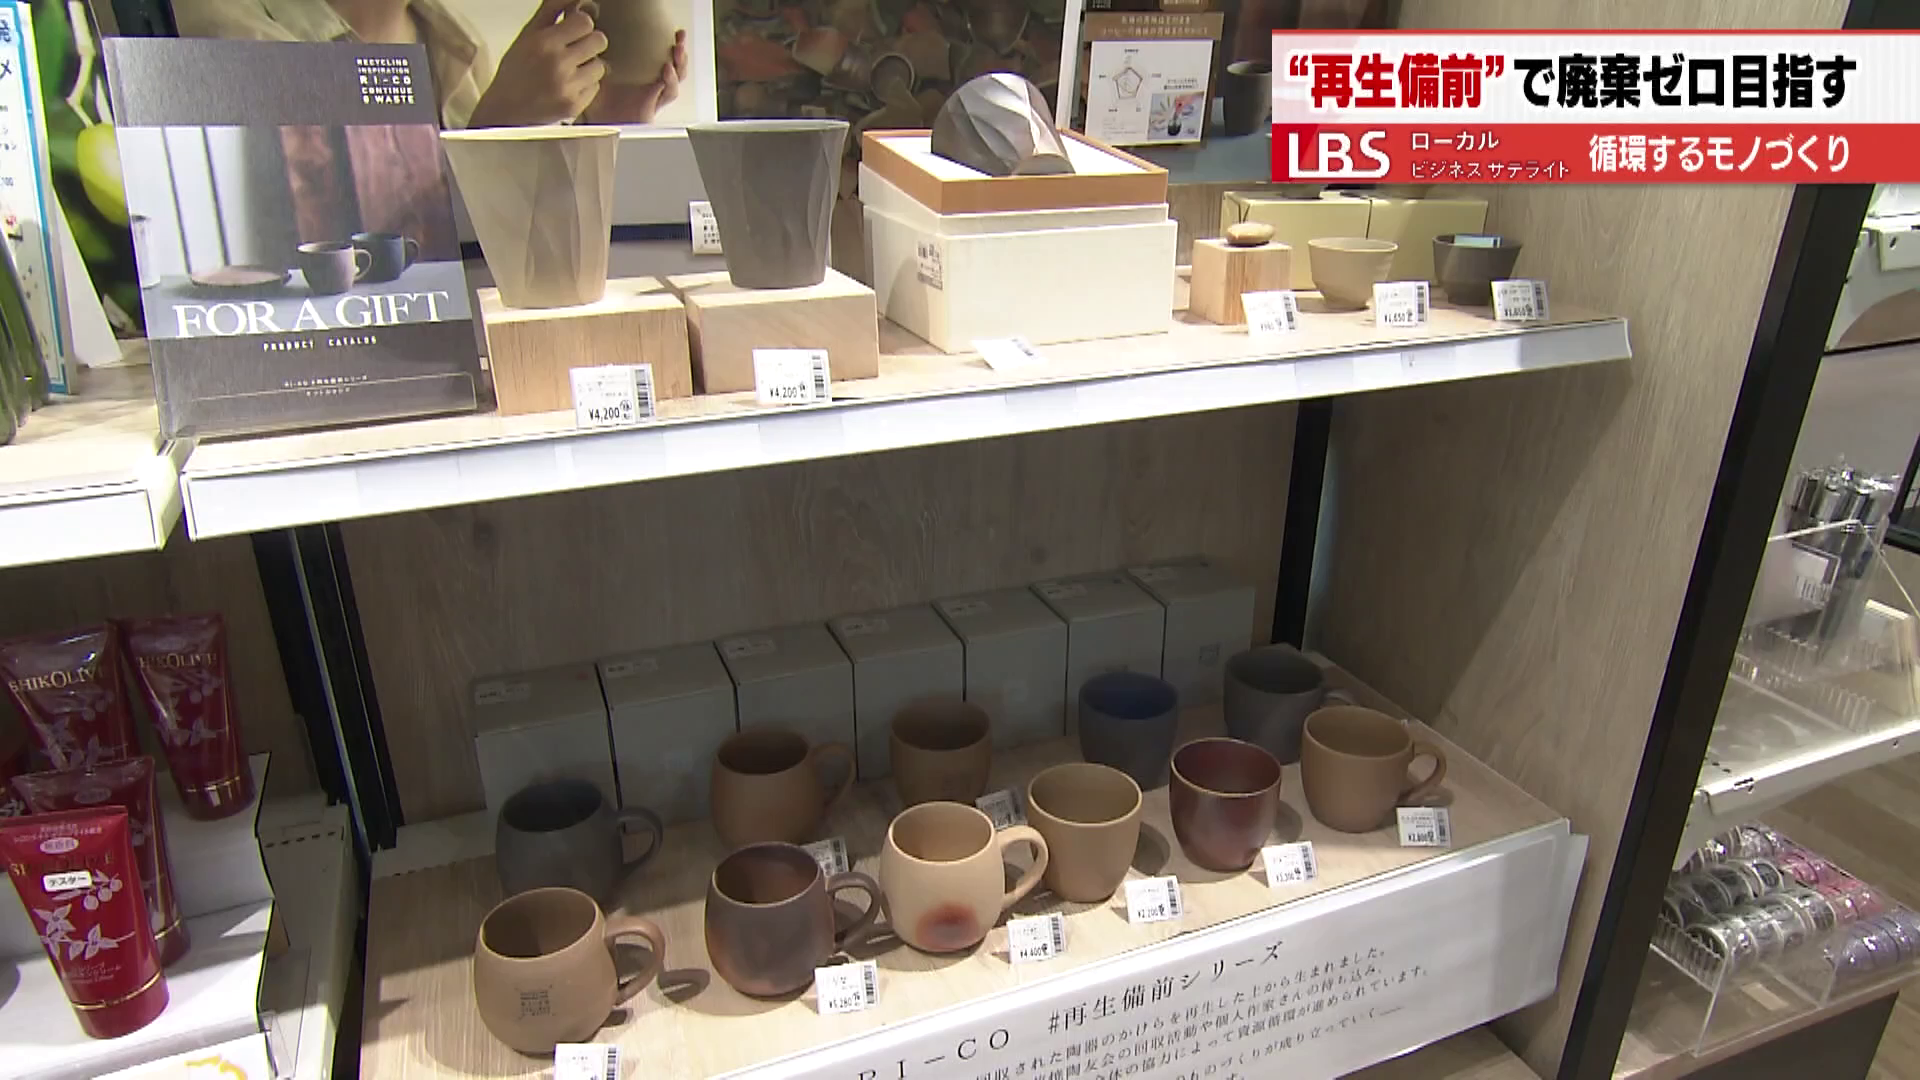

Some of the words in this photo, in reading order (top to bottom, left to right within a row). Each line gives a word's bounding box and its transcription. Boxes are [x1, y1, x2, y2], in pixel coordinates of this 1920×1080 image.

[356, 58, 409, 67] RECYCLING
[358, 67, 411, 75] INSPIRATION
[362, 87, 413, 95] CONTINUE
[375, 95, 415, 105] WASTE
[171, 300, 285, 338] FOR
[291, 298, 329, 332] A
[335, 290, 449, 328] GIFT
[263, 341, 316, 352] PRODUCT
[328, 335, 377, 346] CATALOG
[588, 406, 620, 423] ¥4,200
